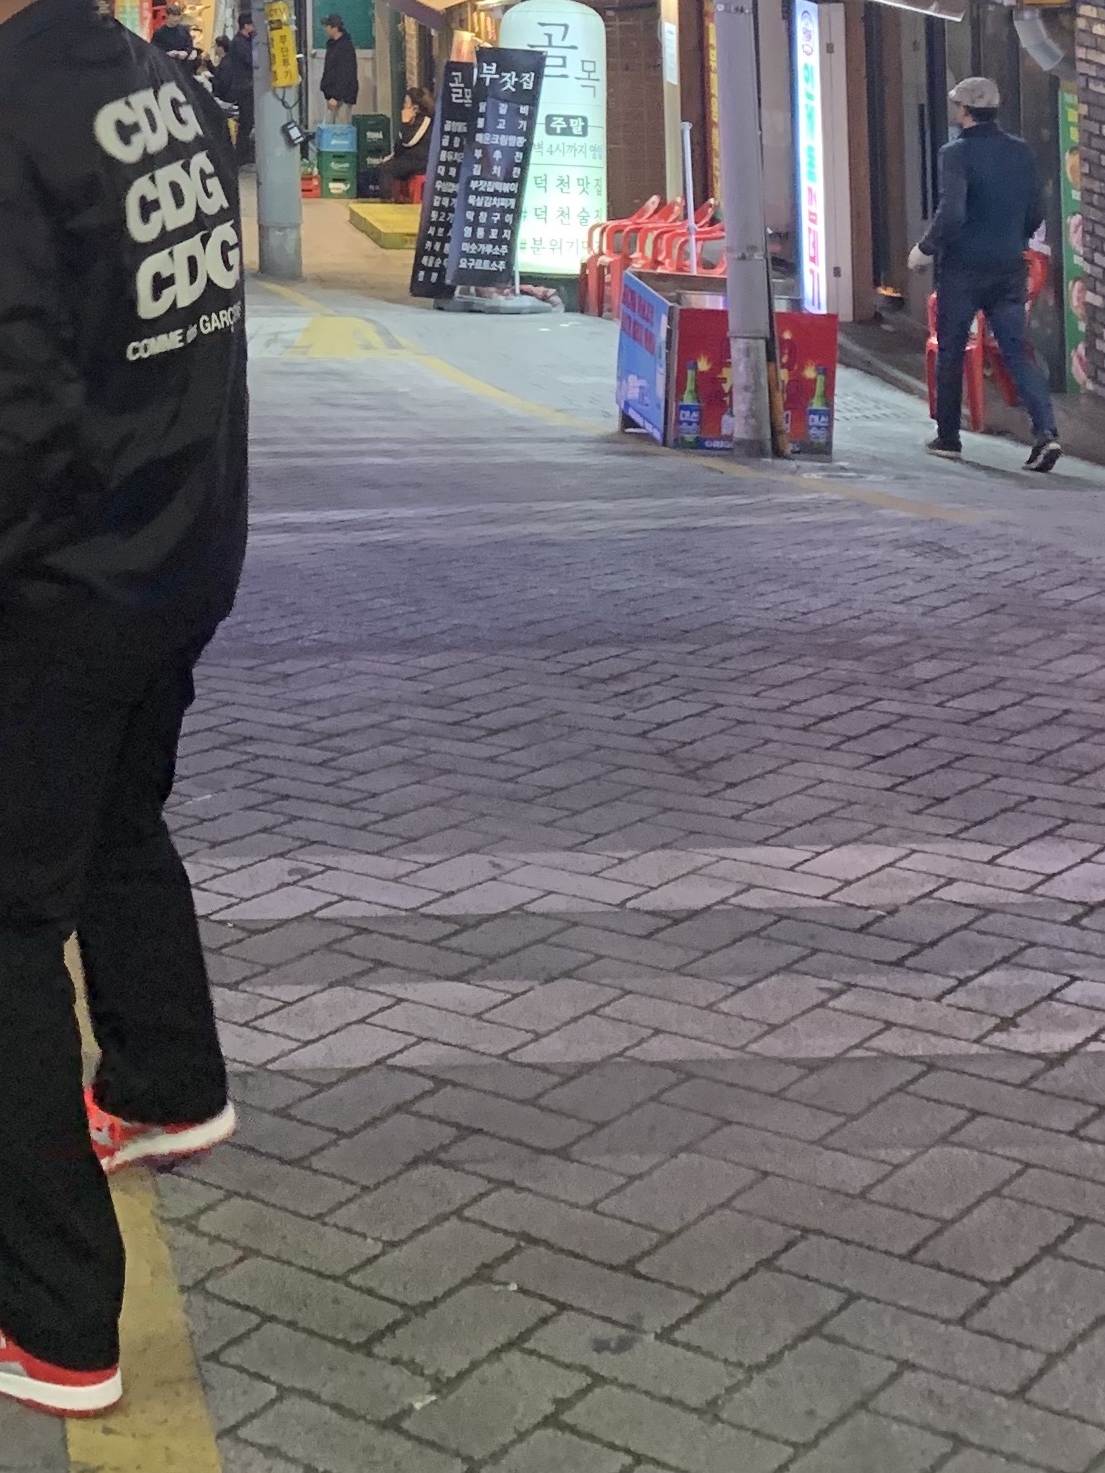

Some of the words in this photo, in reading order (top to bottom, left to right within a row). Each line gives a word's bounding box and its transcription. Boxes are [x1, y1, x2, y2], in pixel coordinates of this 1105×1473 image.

[479, 62, 535, 92] 부잣집
[527, 21, 600, 99] 골목
[94, 81, 203, 164] CDG
[550, 116, 585, 136] 주말
[546, 142, 587, 159] 4시까지
[125, 150, 229, 244] CDG
[136, 219, 241, 318] CDG
[126, 328, 185, 361] COMME
